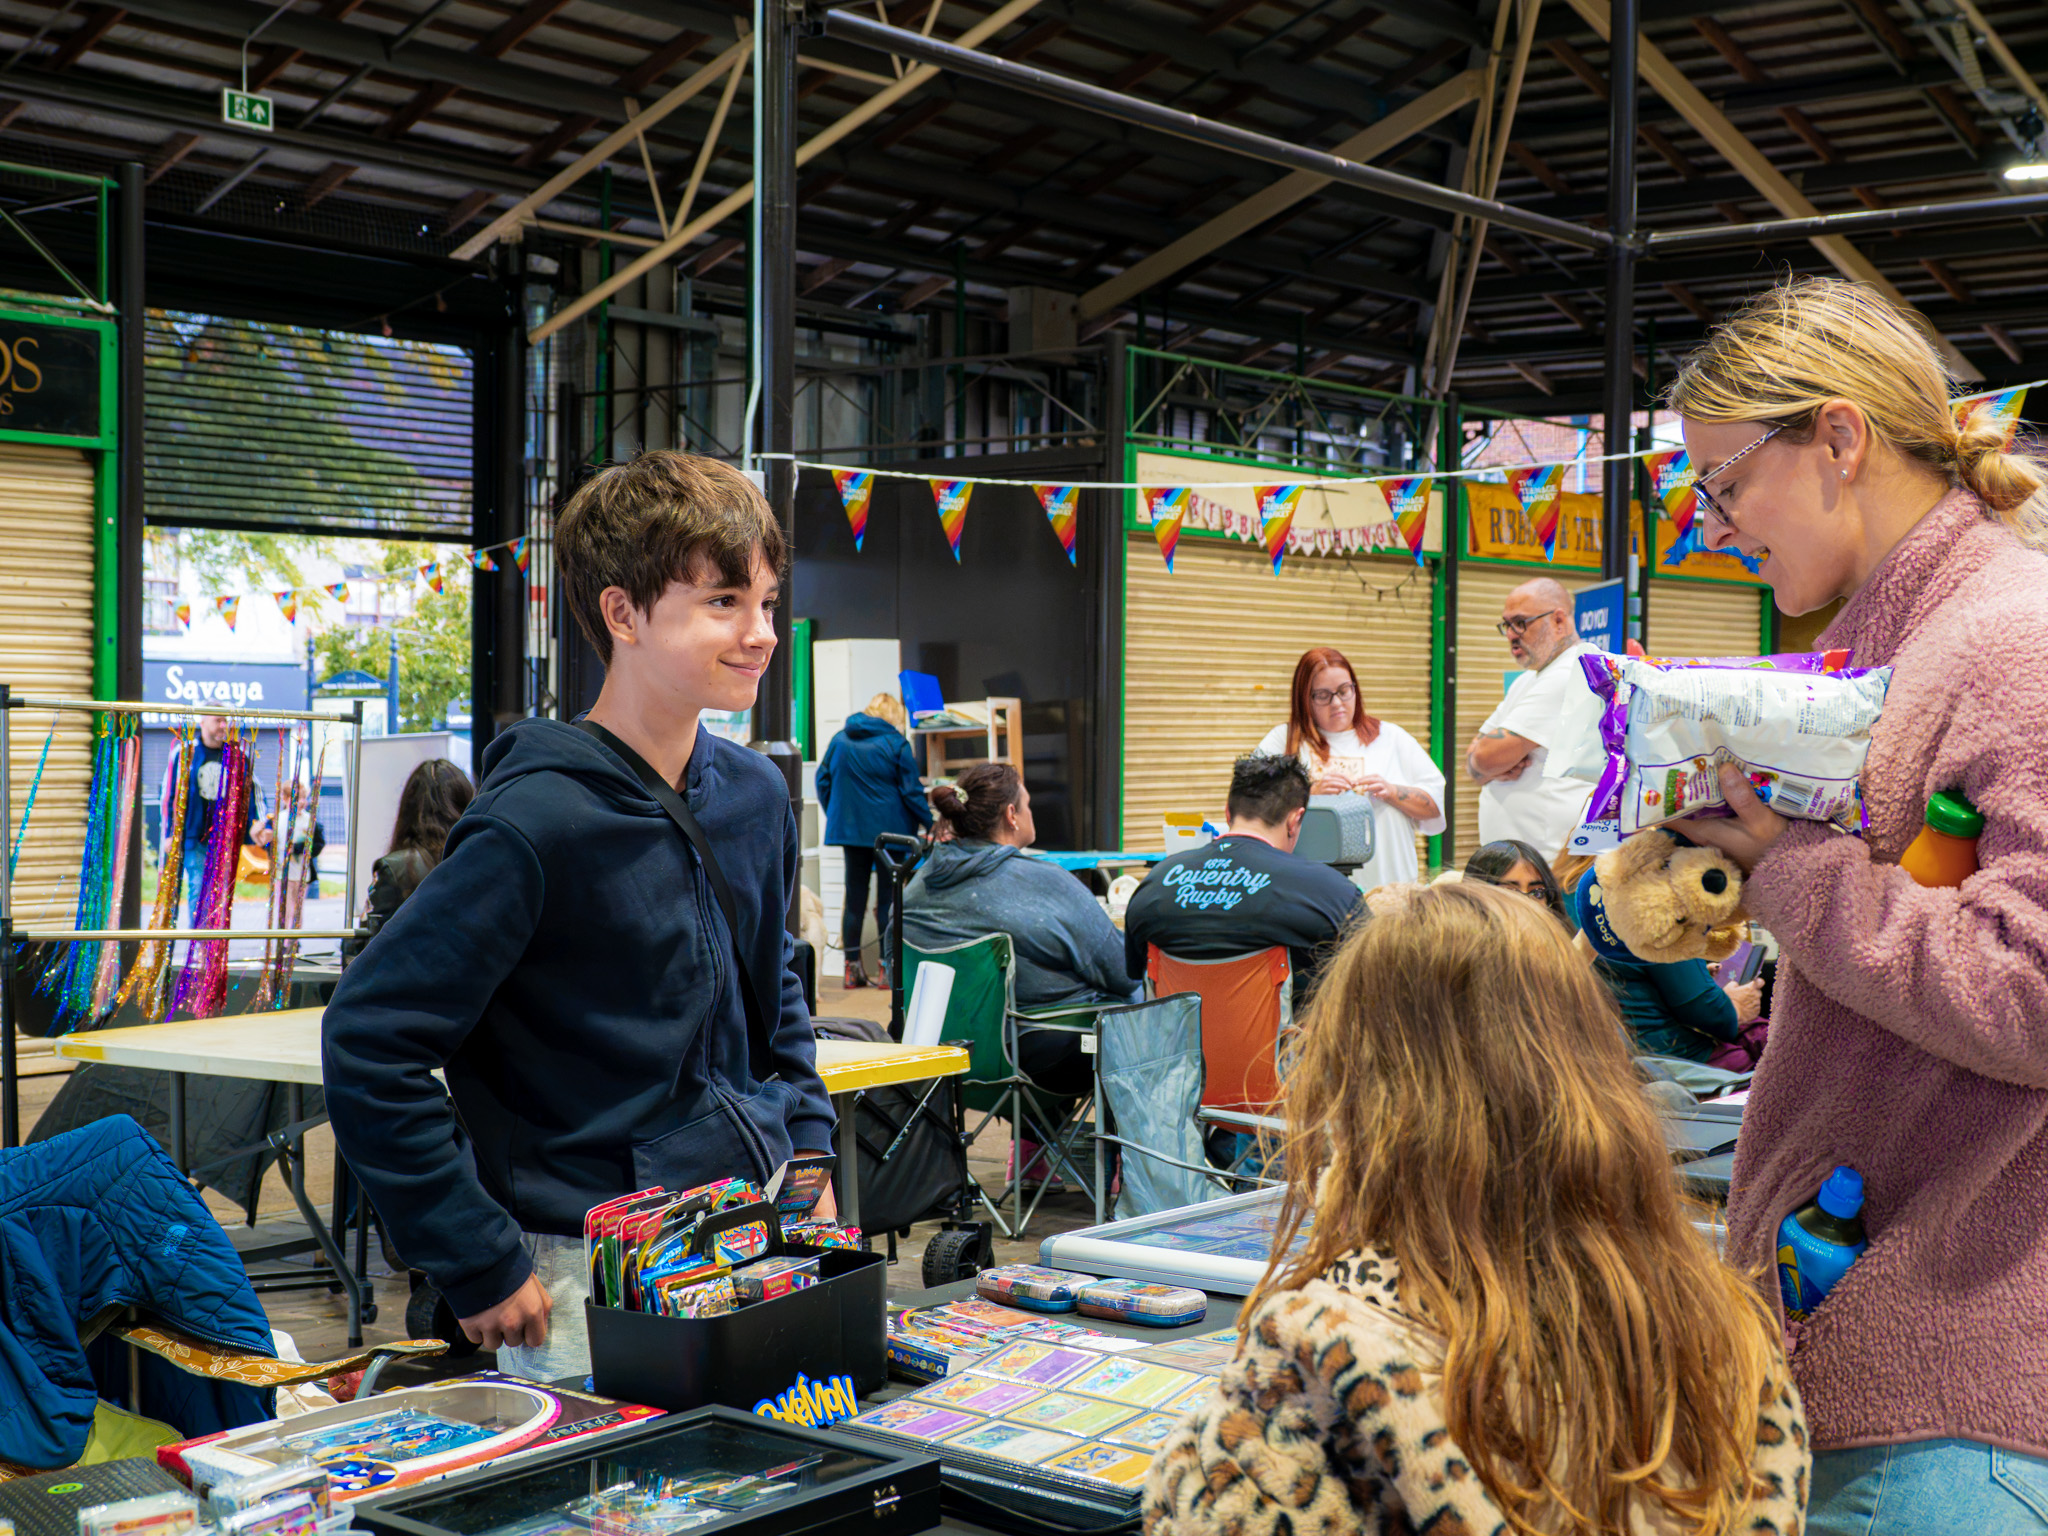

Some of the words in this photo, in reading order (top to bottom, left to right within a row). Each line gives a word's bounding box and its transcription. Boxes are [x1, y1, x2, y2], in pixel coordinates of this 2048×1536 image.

[1658, 463, 1674, 472] THE
[1518, 478, 1535, 487] THE
[1389, 489, 1404, 497] THE
[1520, 485, 1558, 495] TEENAGE
[1391, 496, 1425, 505] TEENAGE
[1522, 493, 1557, 503] MARKET
[1392, 504, 1423, 514] MARKET
[1189, 494, 1298, 547] RIBBOS
[165, 665, 264, 707] Savaya
[1581, 824, 1610, 833] Guide
[1203, 858, 1233, 870] 1874
[1162, 864, 1271, 895] Coventry
[1175, 884, 1243, 910] Rugby
[1595, 913, 1618, 946] Dogs
